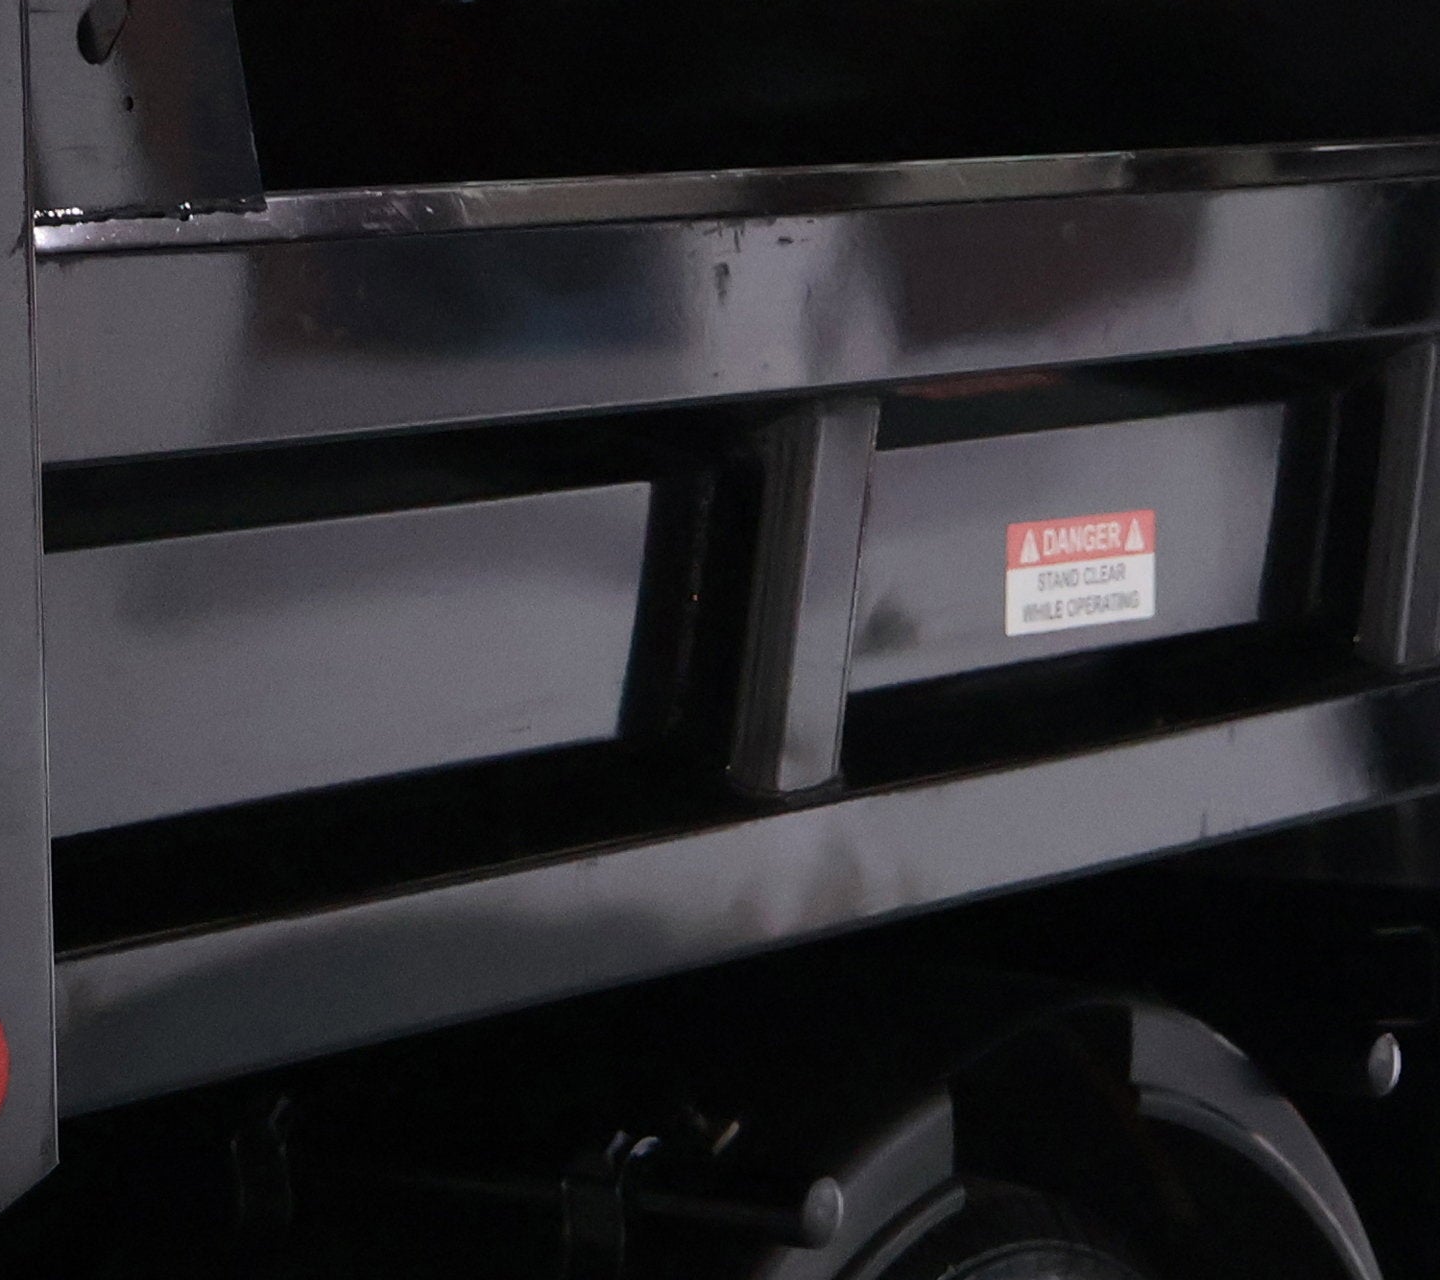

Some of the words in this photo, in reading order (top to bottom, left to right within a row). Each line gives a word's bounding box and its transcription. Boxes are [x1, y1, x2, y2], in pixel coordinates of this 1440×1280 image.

[1043, 521, 1121, 556] DANGER
[1038, 568, 1080, 592] STAND
[1083, 562, 1127, 585] CLEAR
[1023, 599, 1063, 622] WHILE
[1067, 590, 1140, 617] OPERATING
